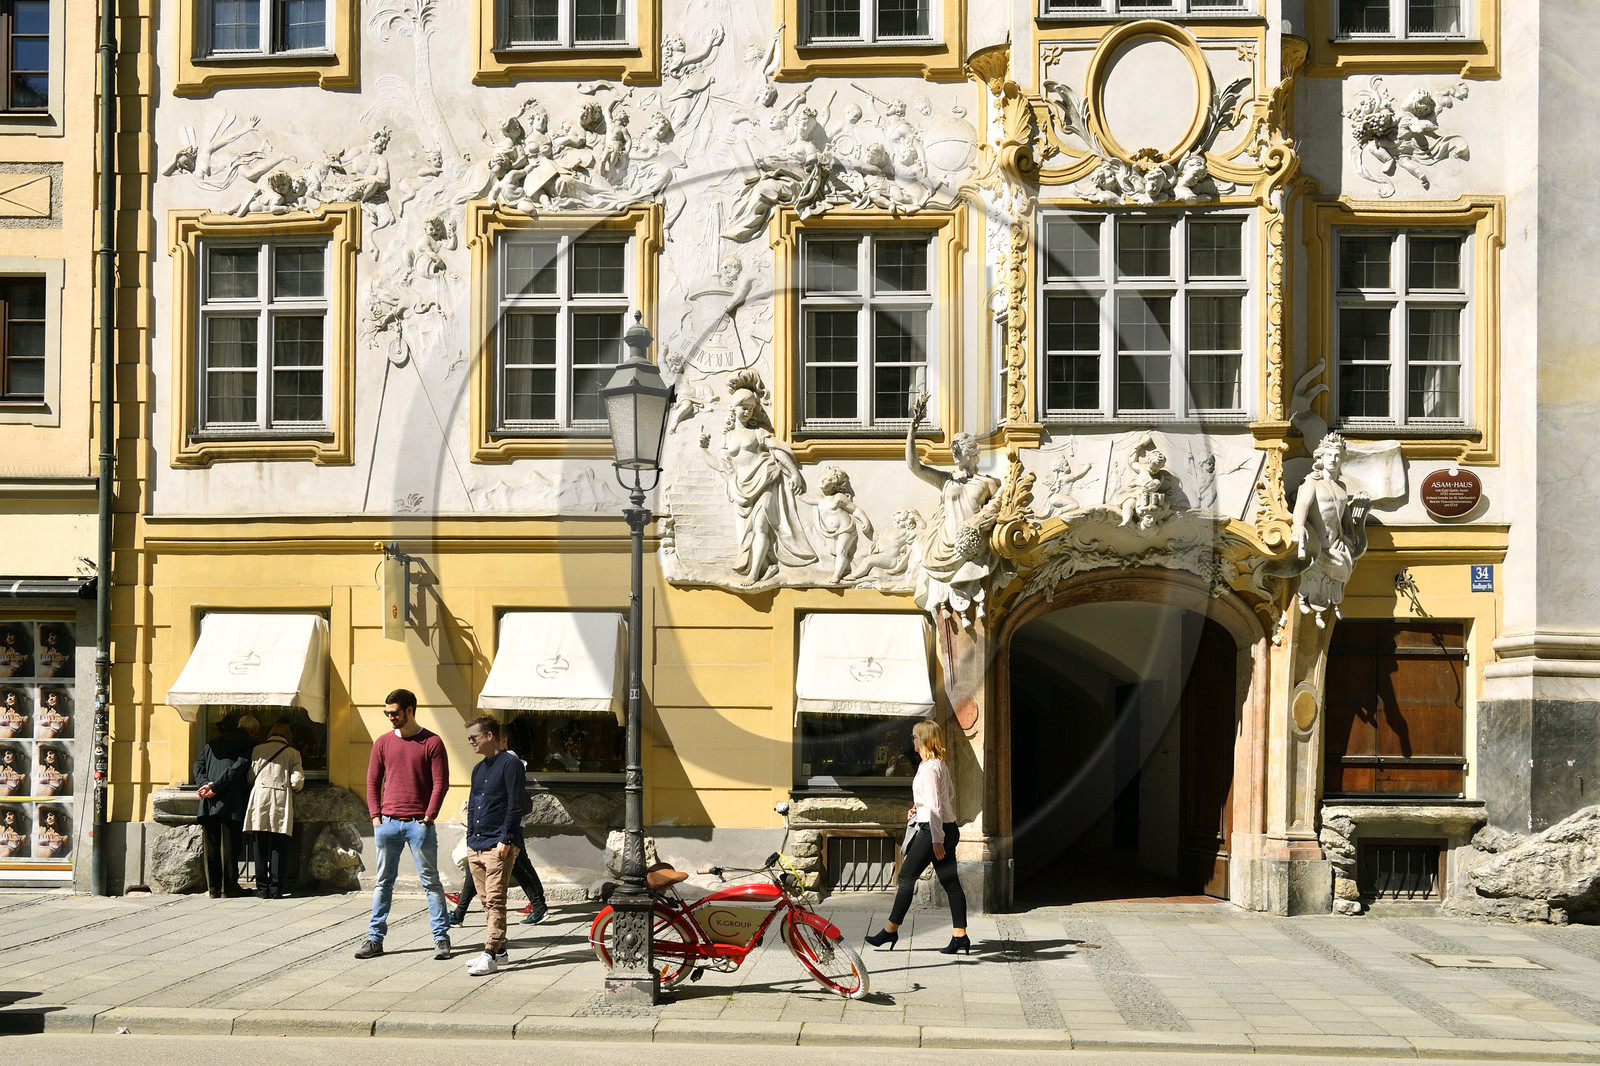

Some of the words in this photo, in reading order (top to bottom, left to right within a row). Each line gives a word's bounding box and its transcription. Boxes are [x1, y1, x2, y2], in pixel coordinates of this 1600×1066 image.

[1475, 567, 1489, 580] 34
[630, 690, 640, 698] 34
[716, 919, 752, 928] K.GROUP
